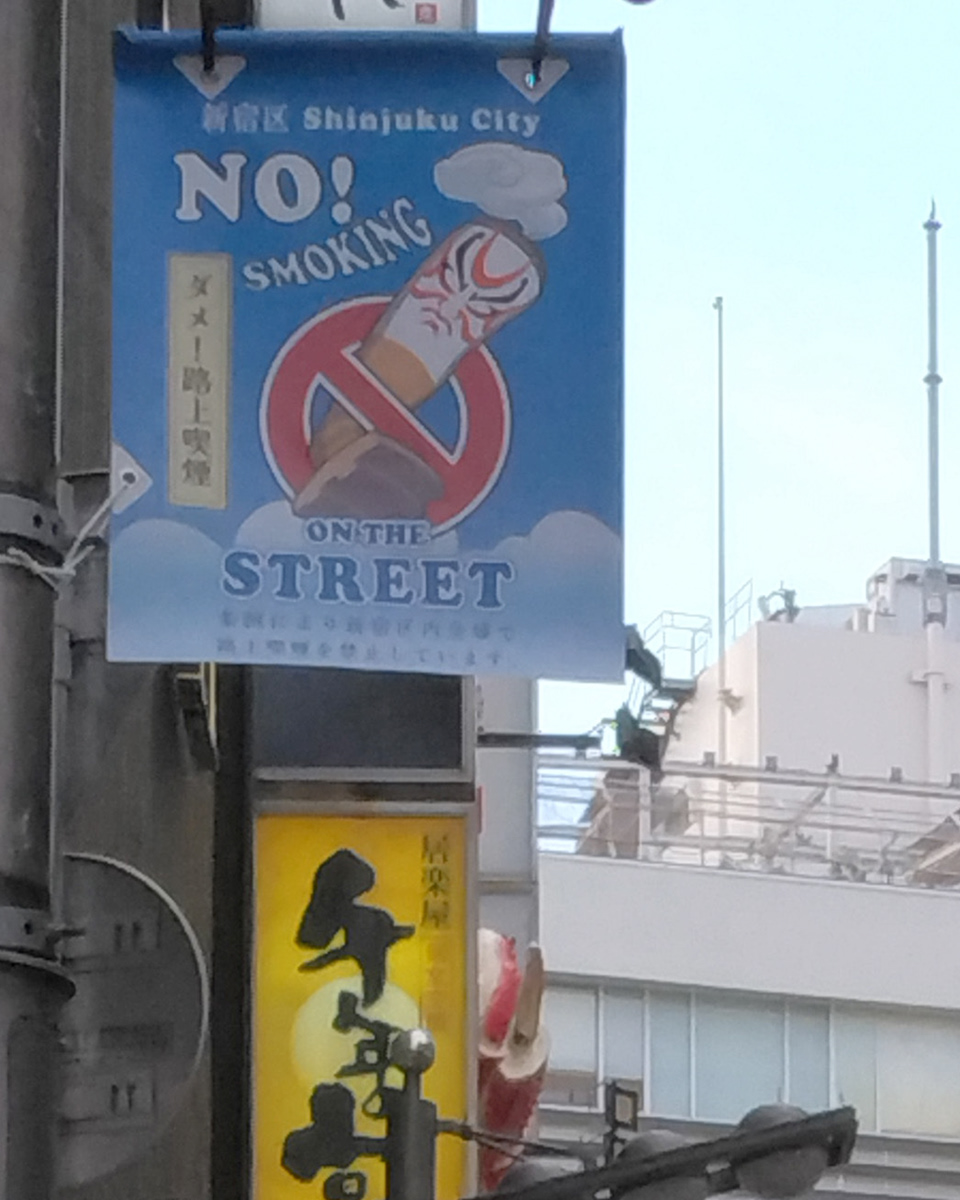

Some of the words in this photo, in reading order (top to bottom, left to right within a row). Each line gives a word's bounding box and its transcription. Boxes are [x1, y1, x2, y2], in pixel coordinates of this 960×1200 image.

[303, 106, 459, 135] Shinjuku
[471, 107, 542, 138] City
[173, 152, 355, 225] NO!
[243, 197, 433, 291] SMOKING
[307, 519, 356, 545] ON
[362, 521, 431, 547] THE
[221, 550, 515, 609] STREET
